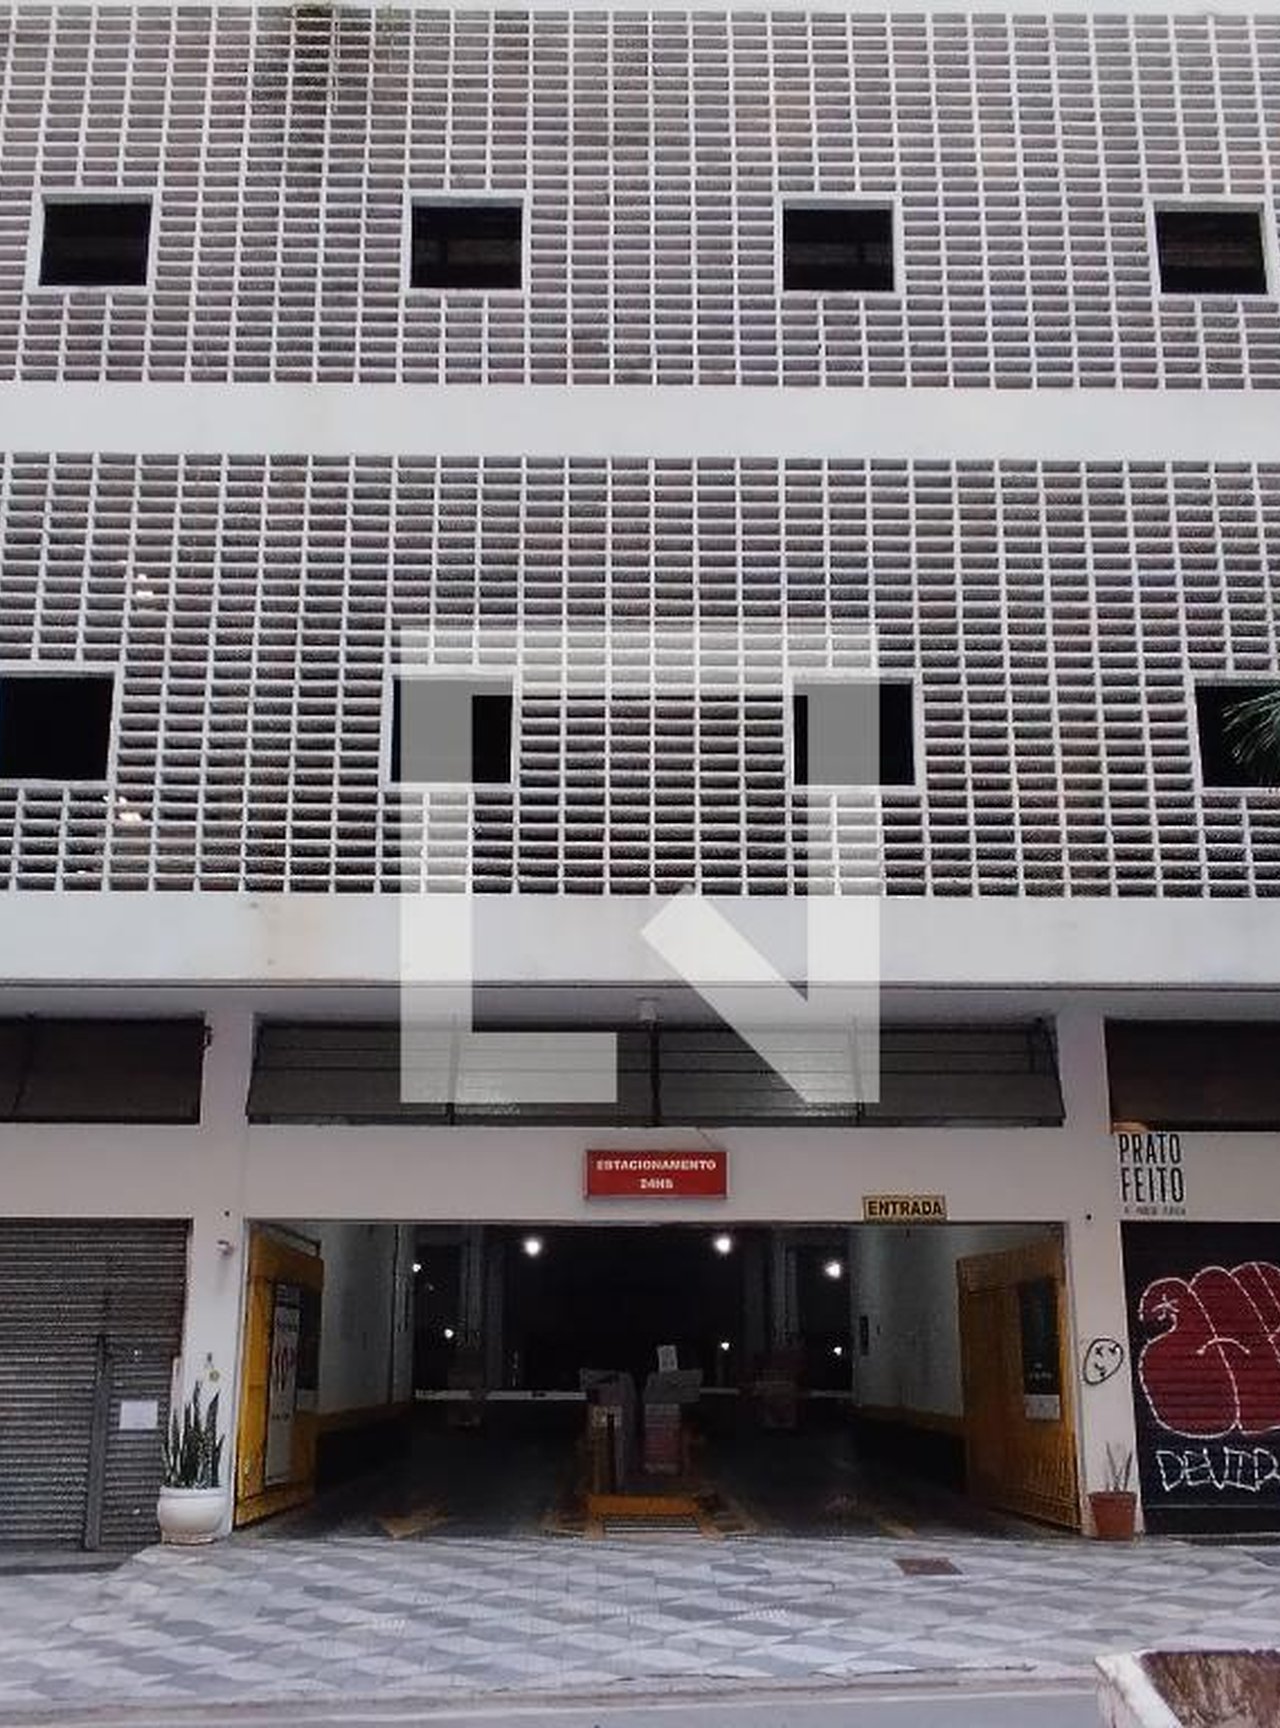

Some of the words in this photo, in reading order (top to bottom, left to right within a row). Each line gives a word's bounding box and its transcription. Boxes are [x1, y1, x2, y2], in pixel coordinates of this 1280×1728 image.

[1119, 1133, 1181, 1164] PRATO
[596, 1160, 717, 1171] ESTACIONAMENTO
[1121, 1167, 1184, 1202] FEITO
[868, 1201, 944, 1216] ENTRADA
